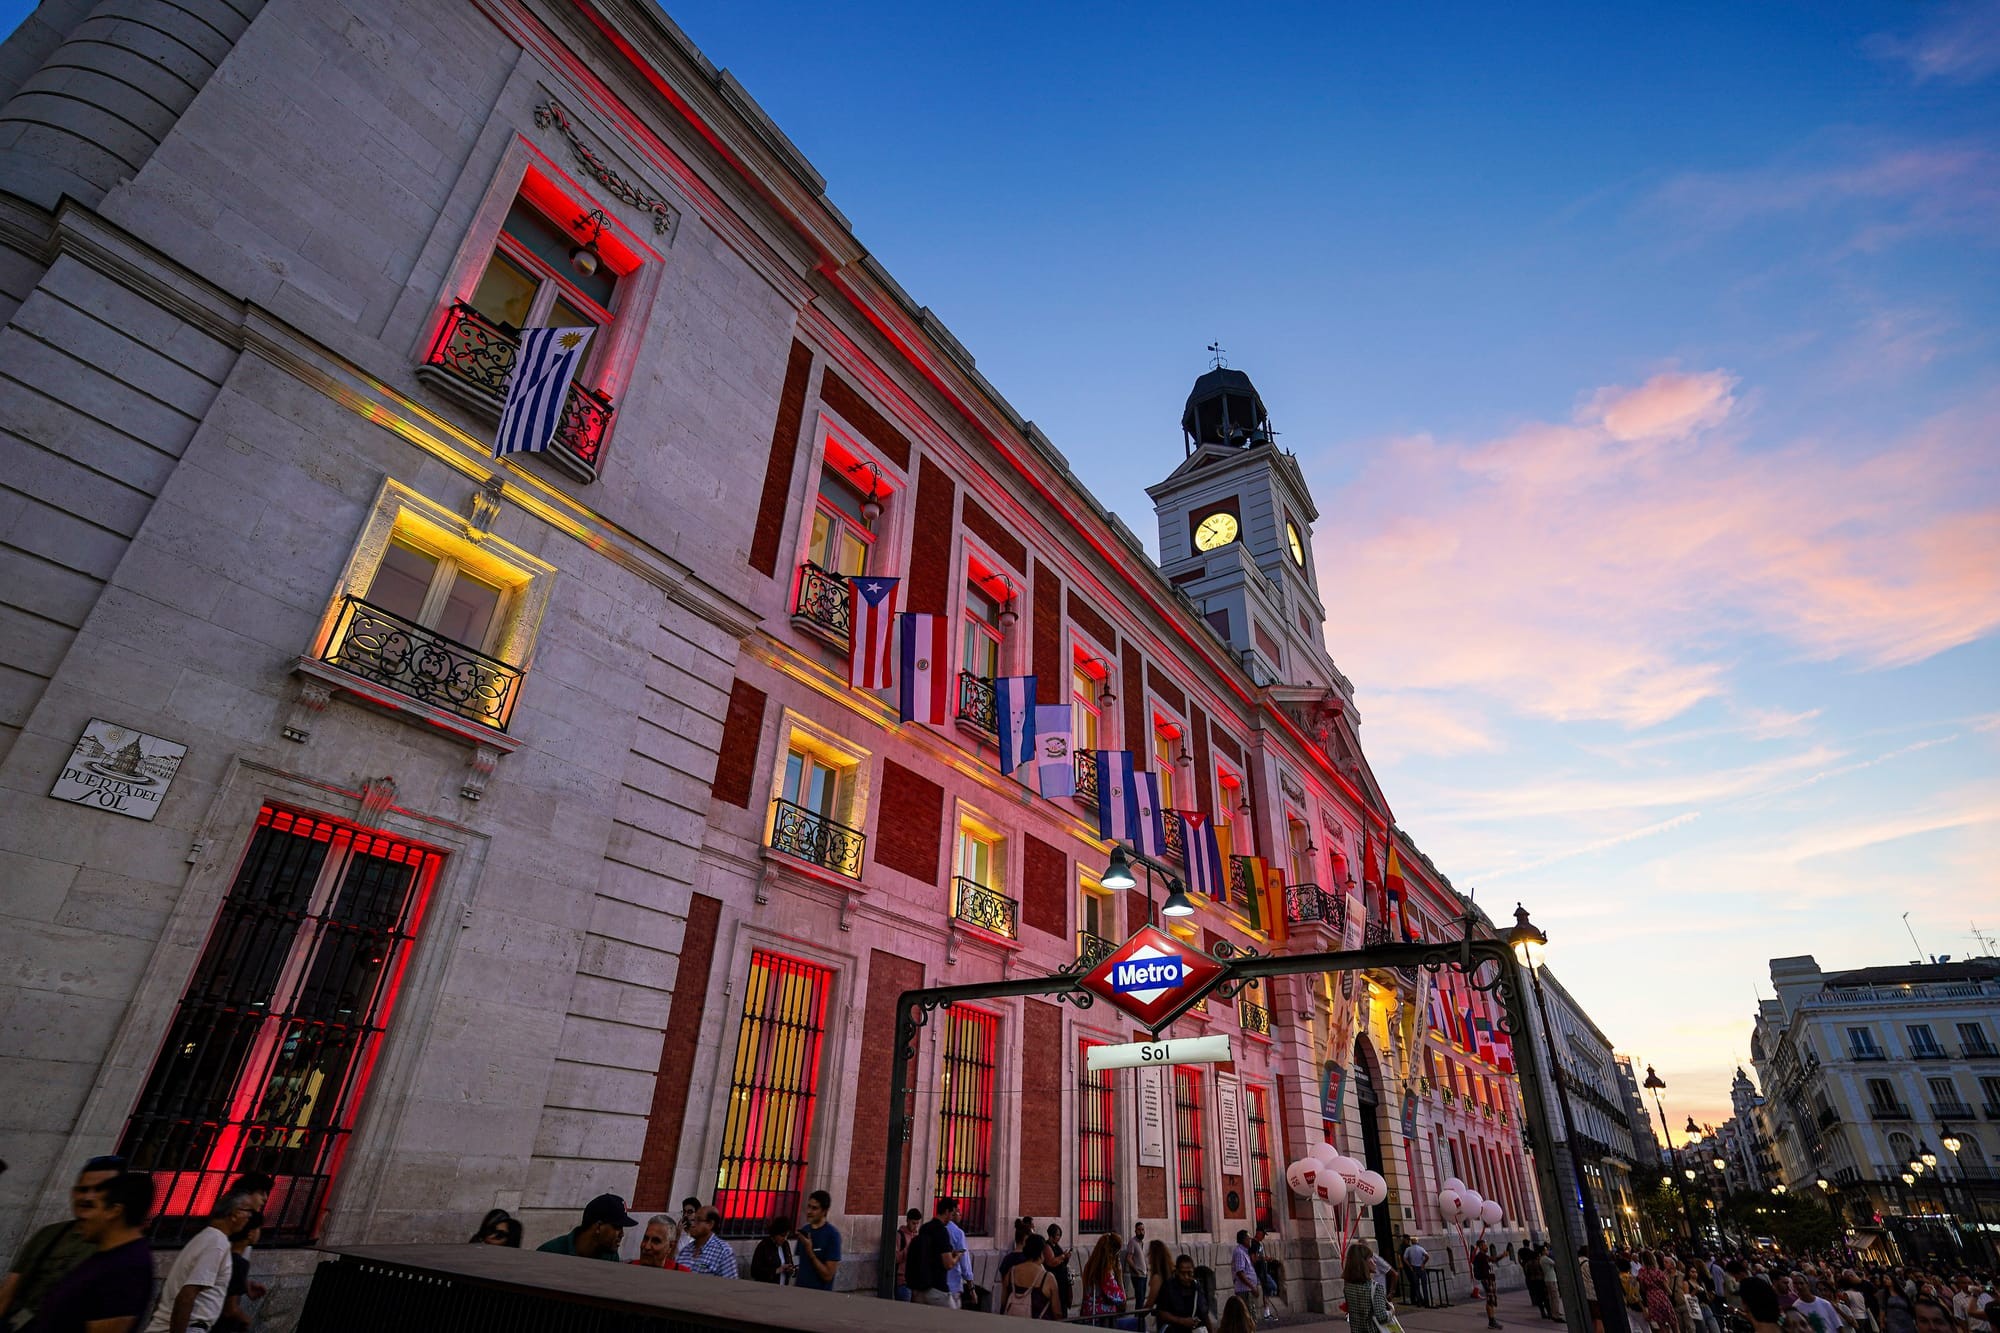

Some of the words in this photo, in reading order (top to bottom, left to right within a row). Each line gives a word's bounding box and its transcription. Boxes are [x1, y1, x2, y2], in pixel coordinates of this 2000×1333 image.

[61, 768, 131, 797] PUERTA
[134, 790, 159, 802] DEL
[70, 789, 128, 811] SOL
[1118, 964, 1178, 986] Metro
[1141, 1044, 1170, 1061] Sol
